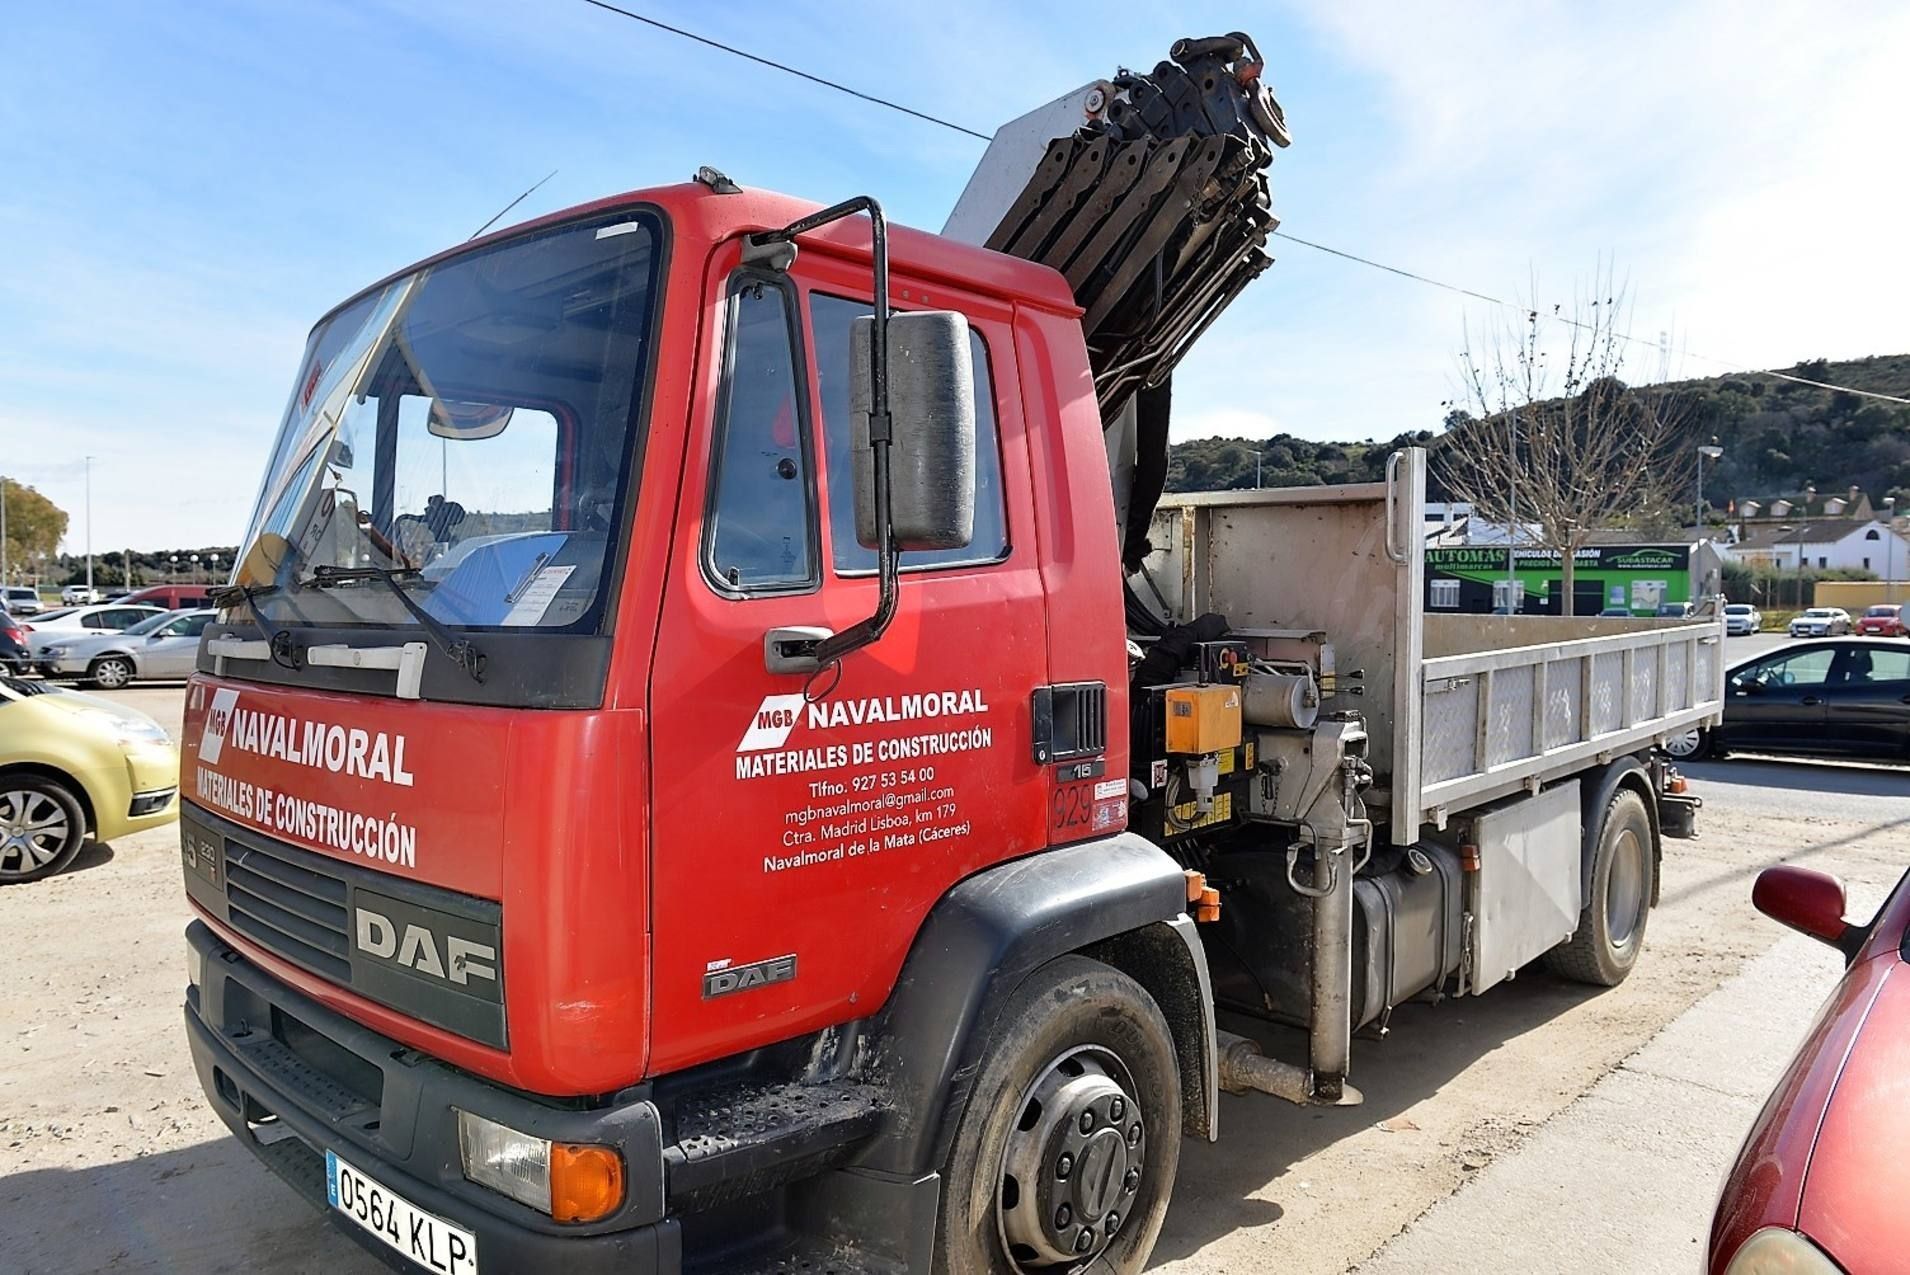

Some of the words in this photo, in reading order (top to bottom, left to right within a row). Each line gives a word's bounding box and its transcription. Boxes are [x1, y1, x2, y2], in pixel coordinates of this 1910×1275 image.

[208, 709, 226, 737] MGB
[757, 709, 793, 729] MGB
[808, 689, 989, 730] NAVALMORAL
[232, 708, 414, 787] NAVALMORAL
[736, 745, 848, 779] MATERIALES
[852, 742, 874, 765] DE
[878, 724, 992, 761] CONSTRUCCIÓN
[808, 780, 848, 798] Tlfno.
[852, 774, 877, 791] 927
[881, 772, 897, 787] 53
[900, 769, 916, 784] 54
[919, 766, 935, 781] 00
[196, 766, 253, 819] MATERIALES
[256, 786, 273, 827] DE
[275, 791, 416, 868] CONSTRUCCIÓN
[783, 829, 816, 847] Ctra.
[820, 817, 867, 840] Madrid
[870, 813, 912, 831] Lisboa,
[915, 808, 933, 823] km
[936, 803, 957, 819] 179
[785, 787, 955, 826] mgbnavalmoral@gmail.com
[1054, 784, 1091, 829] 929
[763, 842, 844, 873] Navalmoral
[848, 840, 865, 857] de
[869, 837, 881, 852] la
[884, 833, 915, 850] Mata
[918, 819, 971, 845] (Cáceres)
[356, 907, 497, 986] DAF
[710, 959, 792, 995] DAF
[341, 1168, 400, 1244] 0564
[409, 1211, 467, 1275] KLP
